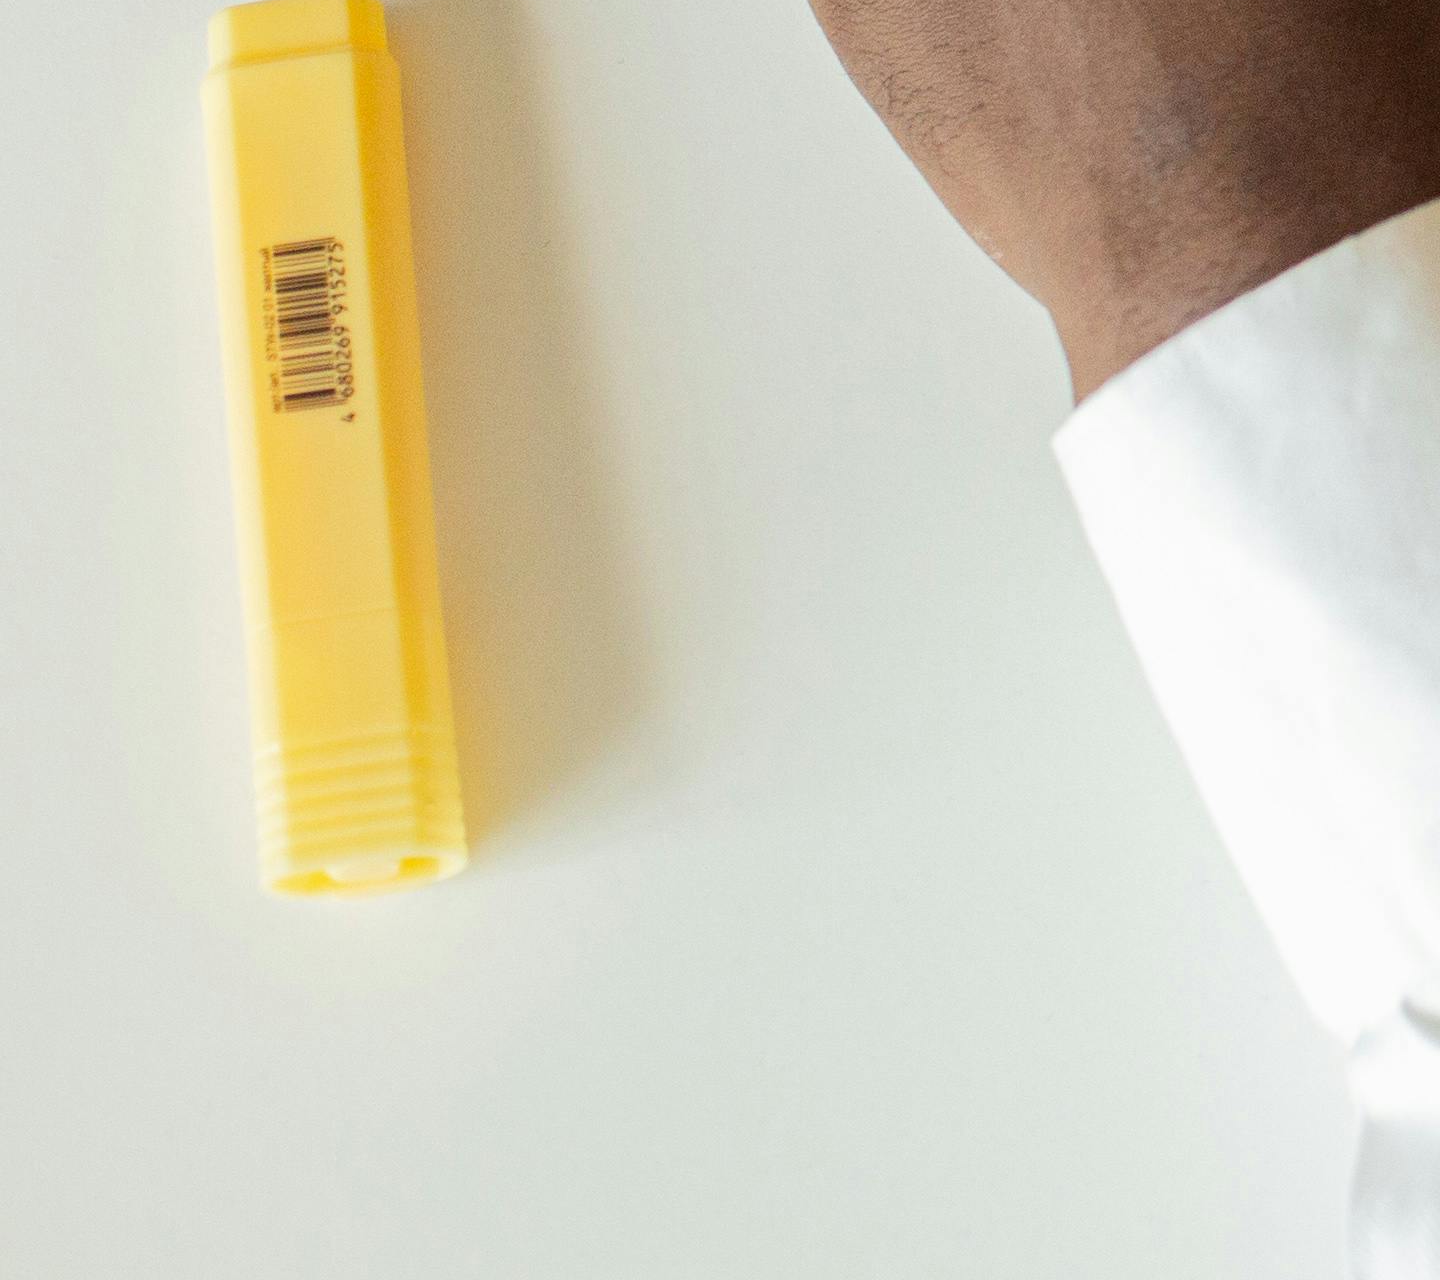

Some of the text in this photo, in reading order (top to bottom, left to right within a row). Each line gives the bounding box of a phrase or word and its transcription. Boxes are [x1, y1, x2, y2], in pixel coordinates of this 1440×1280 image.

[327, 242, 355, 422] 4 680269 915275
